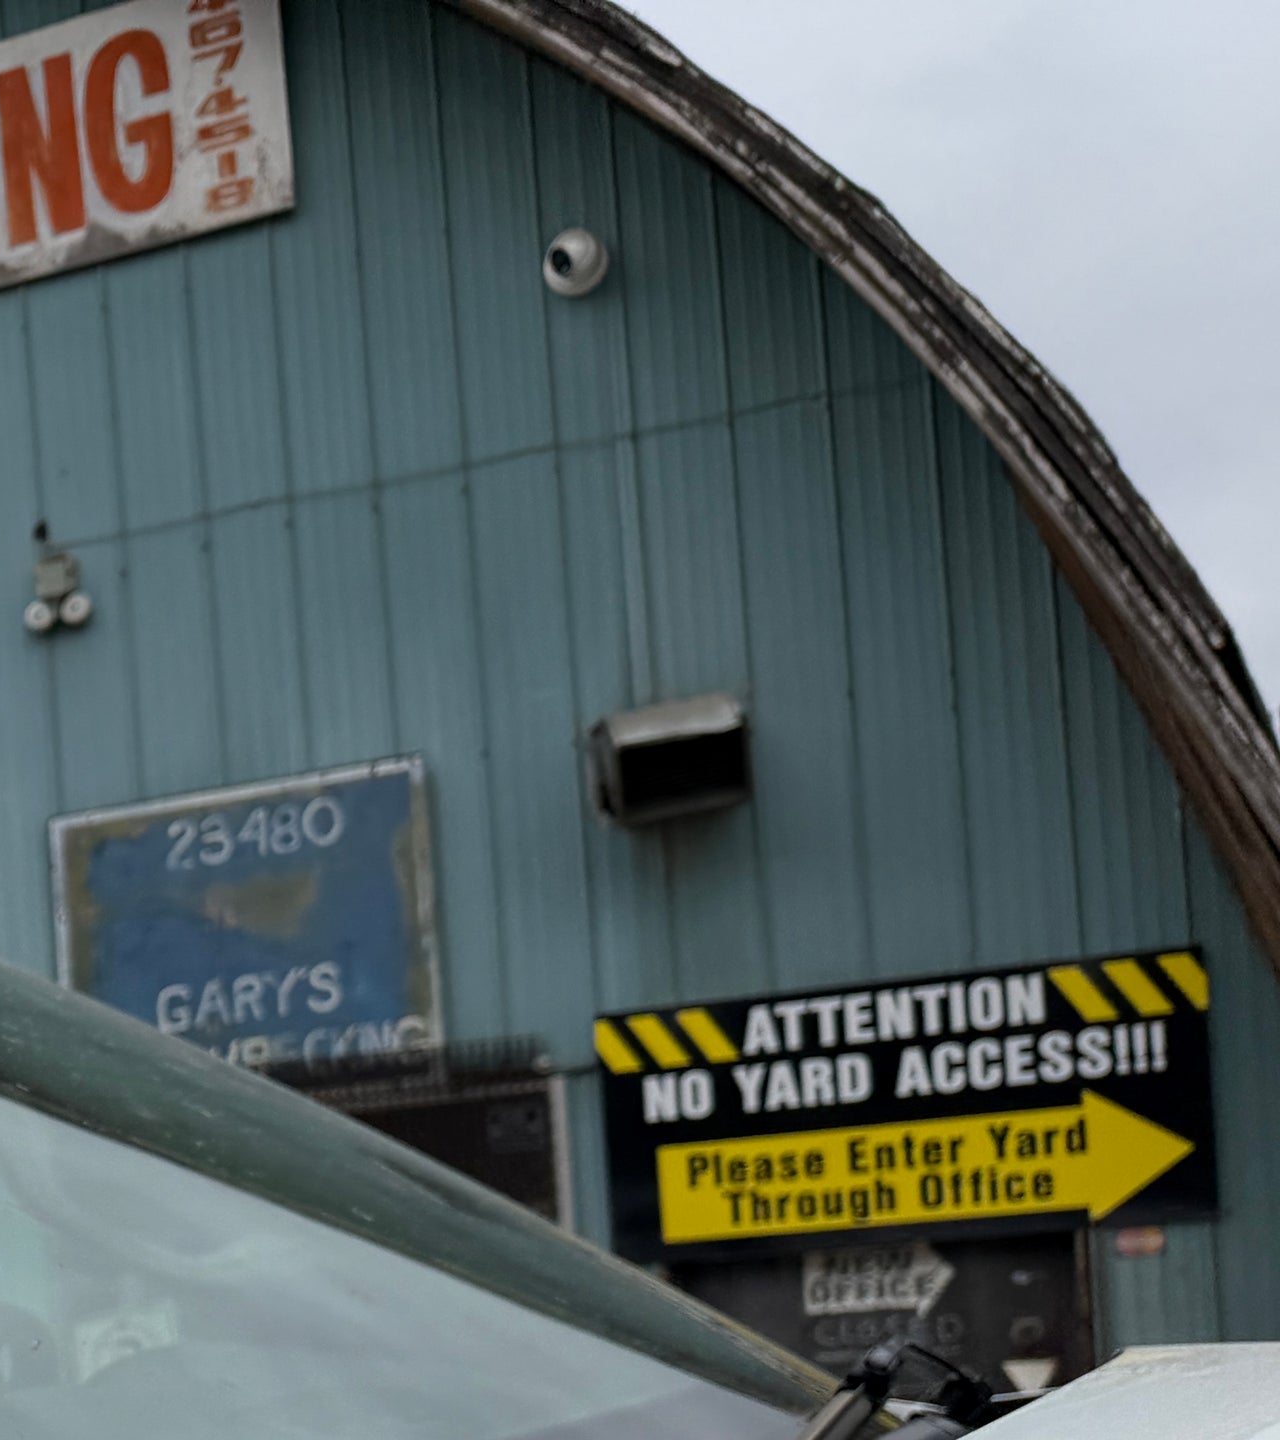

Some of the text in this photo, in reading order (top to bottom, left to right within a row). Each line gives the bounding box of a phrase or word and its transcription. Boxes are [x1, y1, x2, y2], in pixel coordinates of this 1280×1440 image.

[165, 796, 345, 871] 23480
[742, 972, 1046, 1058] ATTENTION
[642, 1020, 1169, 1124] NO YARD ACCESS!!!
[686, 1118, 1089, 1189] Please Enter Yard
[726, 1163, 1054, 1228] Through Office
